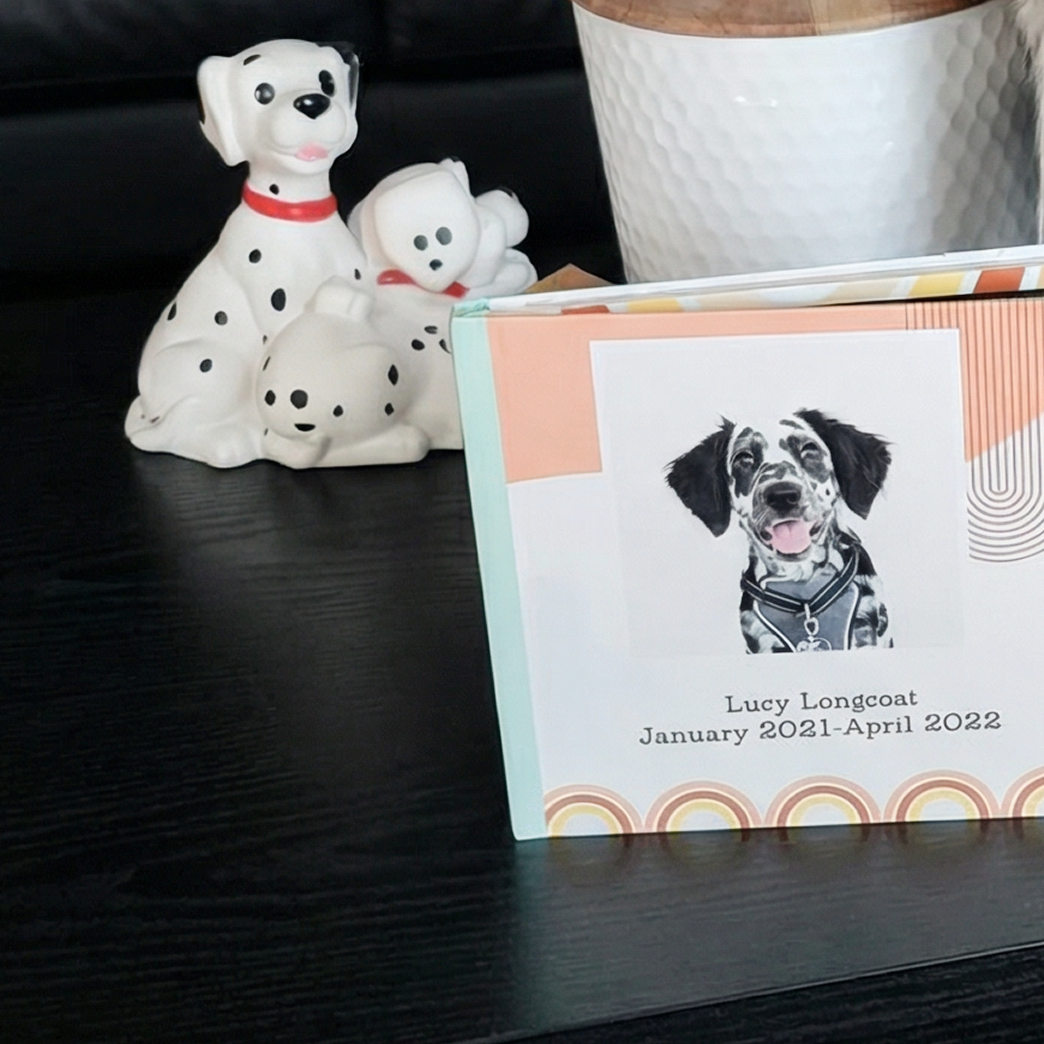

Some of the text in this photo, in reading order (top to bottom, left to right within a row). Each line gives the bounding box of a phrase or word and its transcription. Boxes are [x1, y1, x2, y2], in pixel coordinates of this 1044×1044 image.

[725, 689, 919, 716] Lucy Longcoat
[639, 710, 1002, 746] January 2021-April 2022
